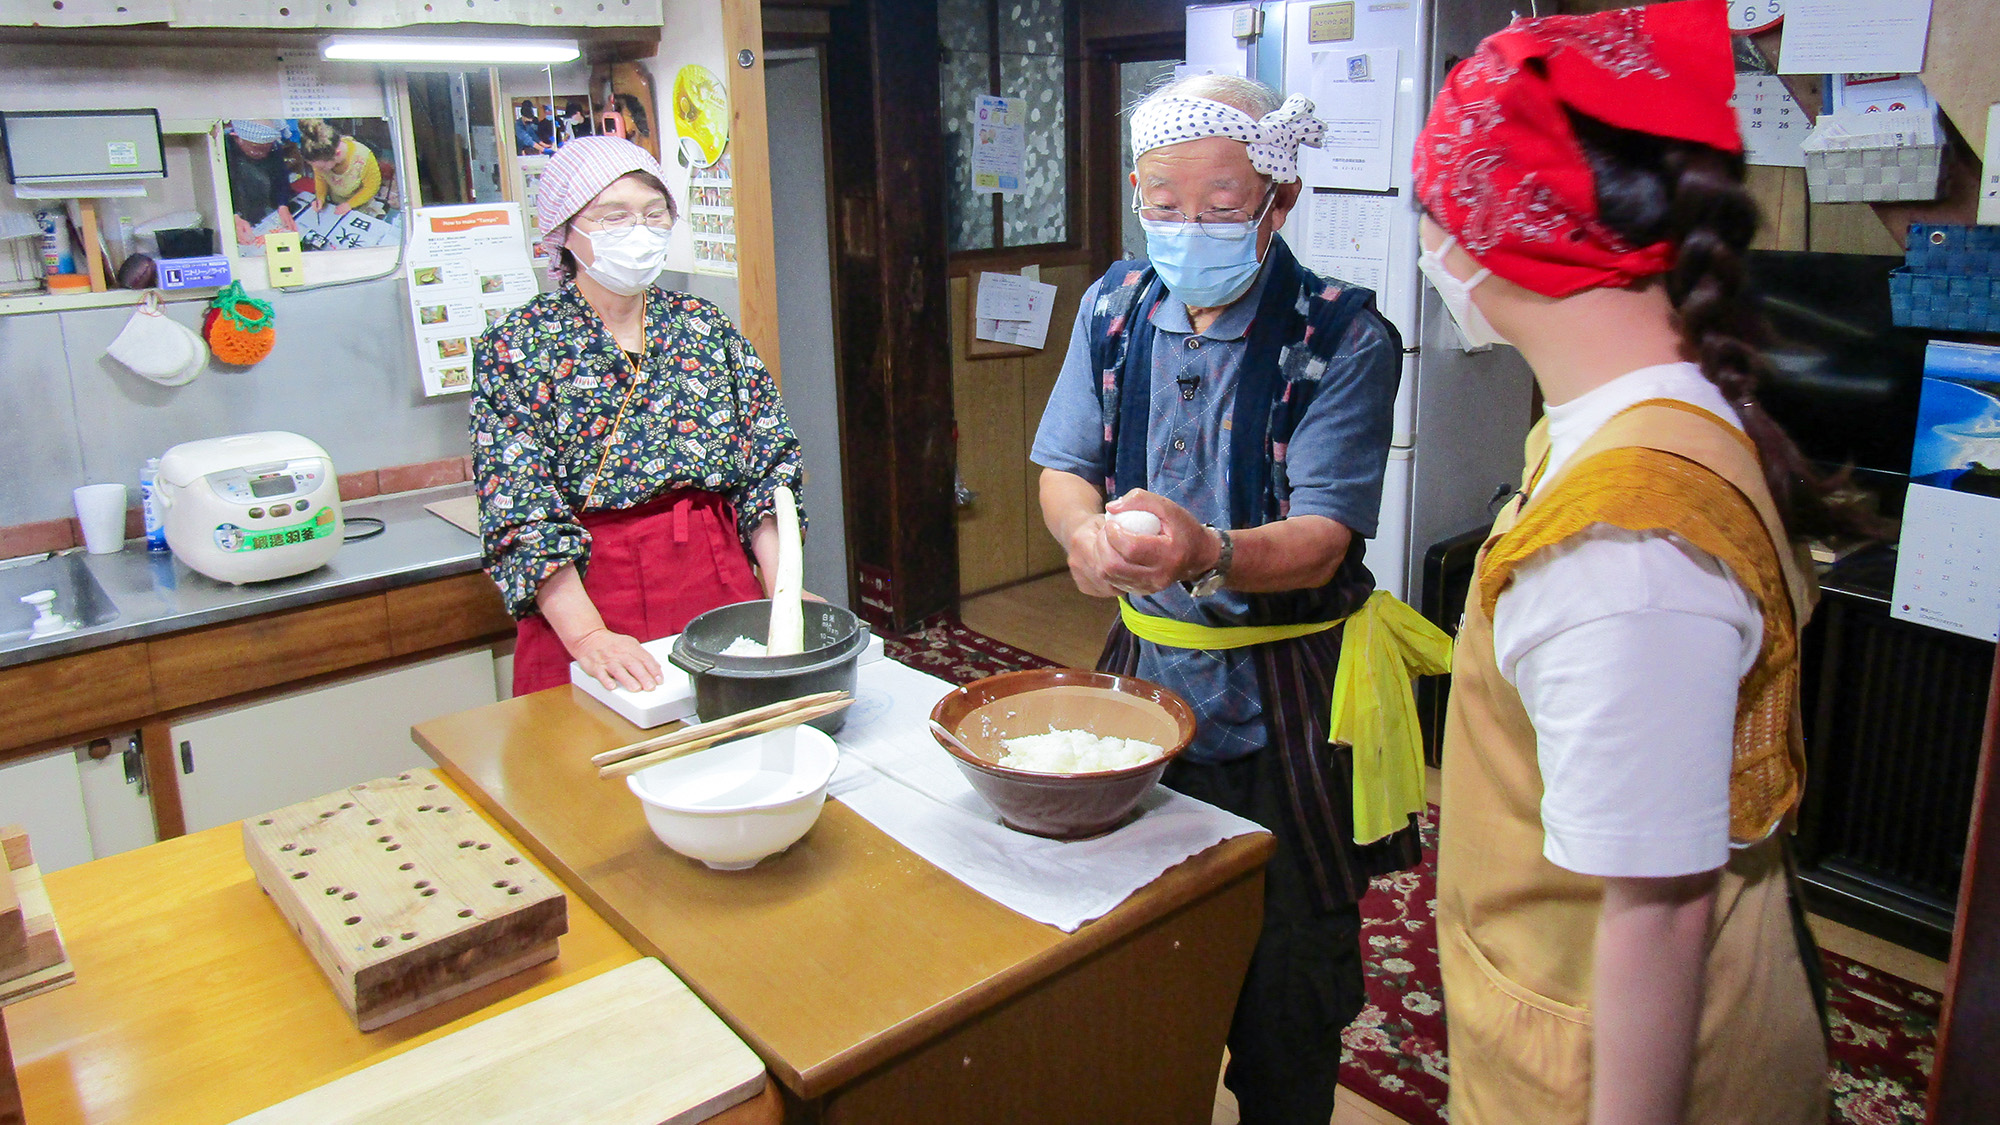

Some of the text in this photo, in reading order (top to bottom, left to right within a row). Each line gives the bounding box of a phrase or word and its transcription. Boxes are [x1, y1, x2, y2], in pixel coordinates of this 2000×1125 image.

[1768, 0, 1780, 13] 5
[1744, 6, 1756, 21] 6
[170, 271, 180, 282] L
